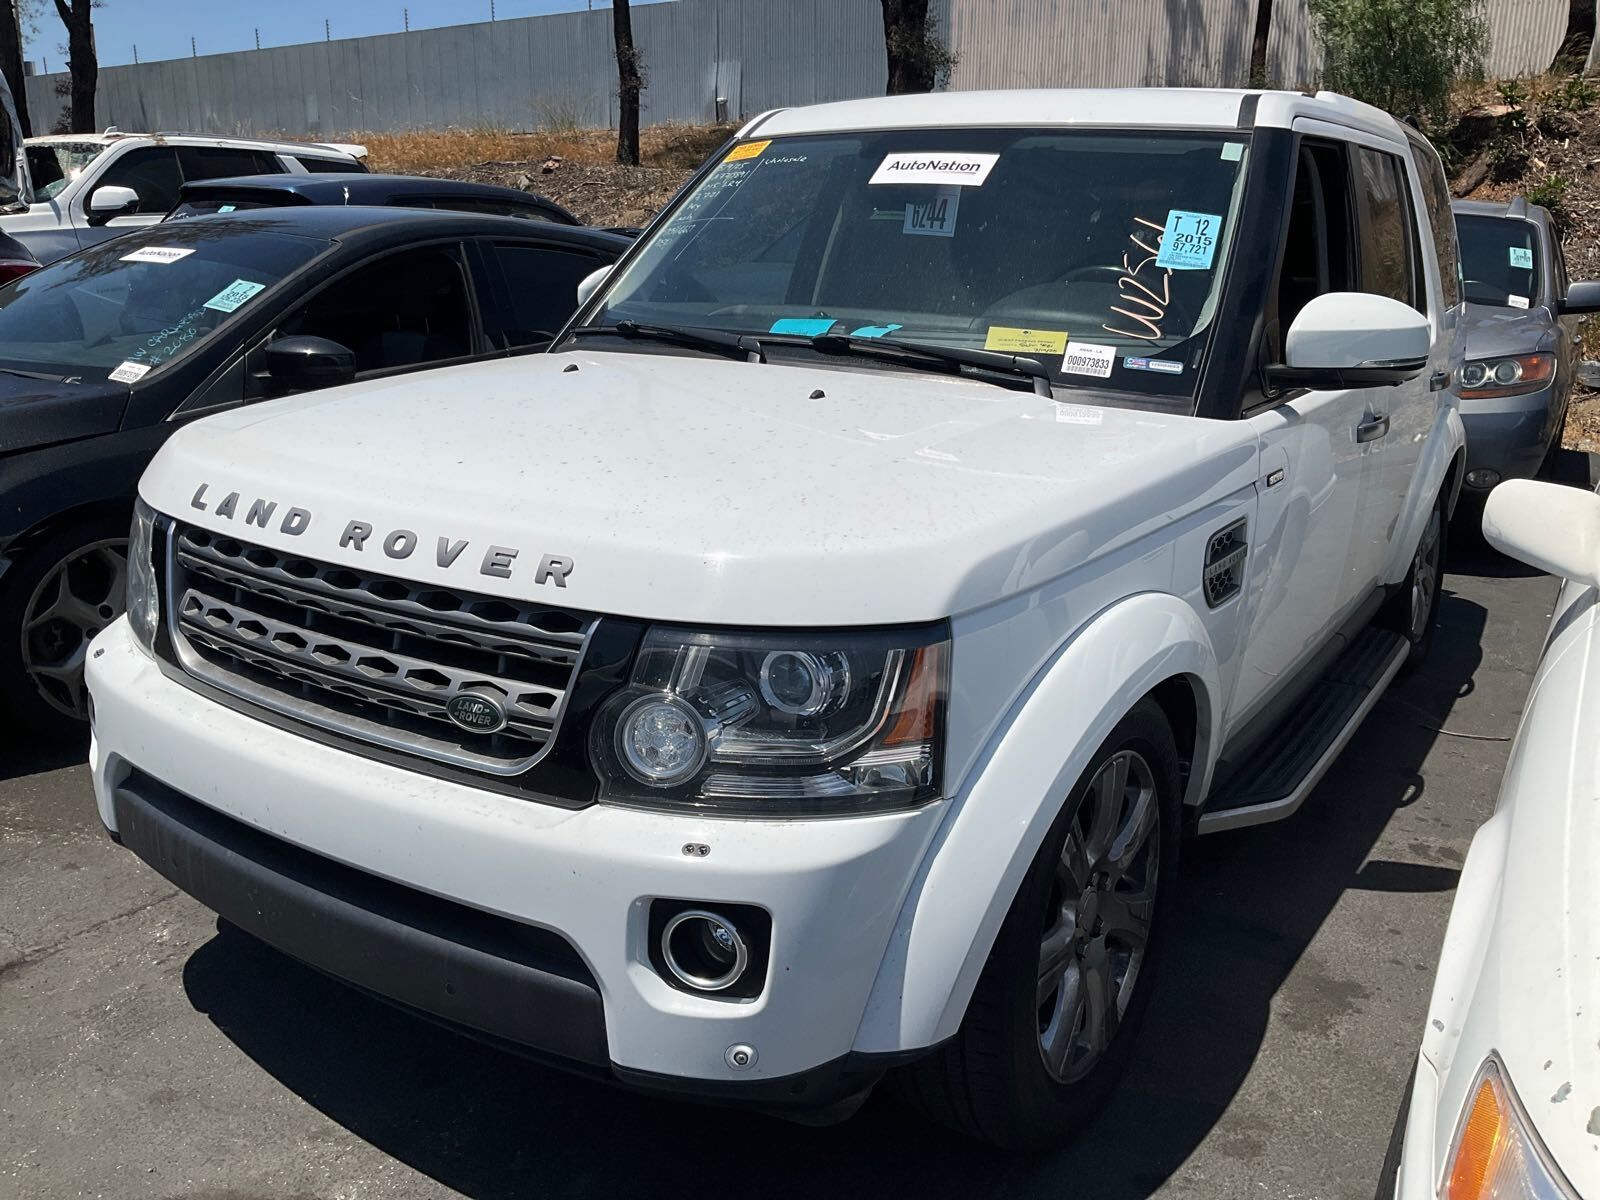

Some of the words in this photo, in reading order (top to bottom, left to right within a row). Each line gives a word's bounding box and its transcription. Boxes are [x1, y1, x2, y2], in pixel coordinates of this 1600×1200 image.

[887, 160, 981, 172] AutoNation
[911, 198, 949, 230] 6244
[1174, 215, 1183, 233] T
[1195, 218, 1210, 237] 12
[1174, 232, 1213, 247] 2015
[1172, 241, 1208, 256] 97,721
[1067, 355, 1110, 370] 000973833
[190, 483, 312, 536] LAND
[339, 519, 574, 588] ROVER
[457, 700, 484, 714] LAND
[458, 710, 492, 726] ROVER
